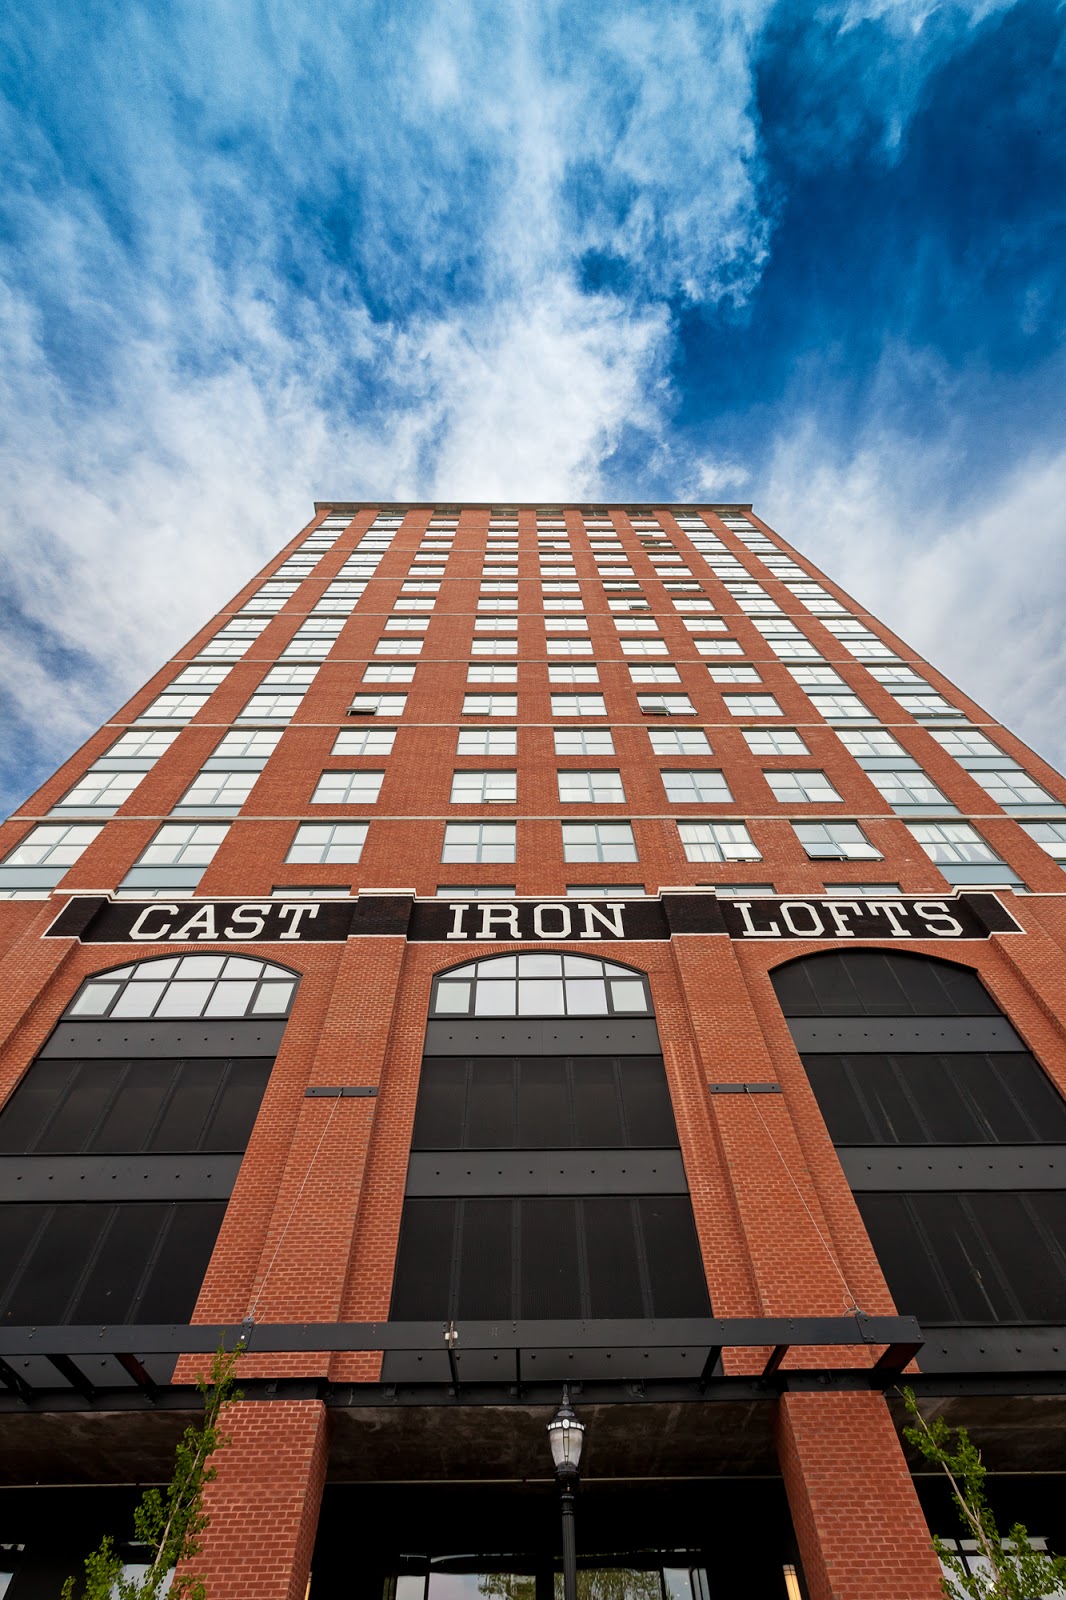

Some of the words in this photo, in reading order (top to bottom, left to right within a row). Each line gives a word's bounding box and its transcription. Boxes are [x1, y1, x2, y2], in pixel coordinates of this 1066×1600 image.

[128, 904, 320, 940] CAST
[446, 903, 626, 939] IRON
[733, 902, 964, 937] LOFTS
